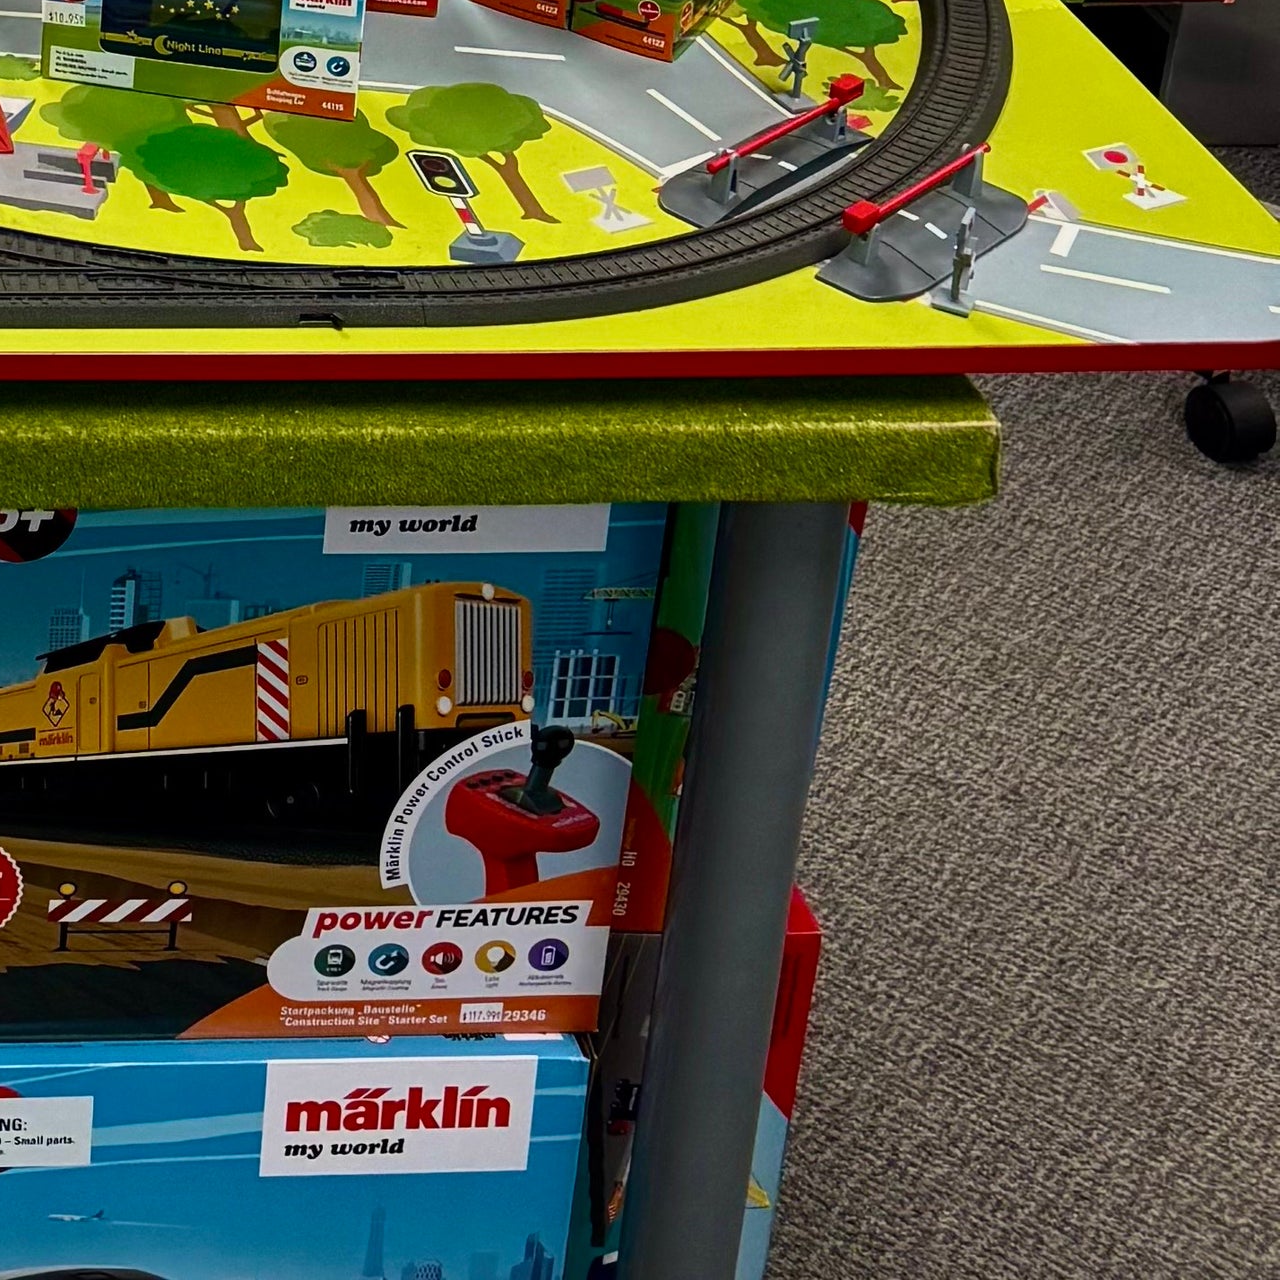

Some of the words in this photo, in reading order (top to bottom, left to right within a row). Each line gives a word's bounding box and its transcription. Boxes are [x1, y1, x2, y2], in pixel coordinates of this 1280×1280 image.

[166, 40, 196, 53] Night
[198, 43, 222, 55] Line
[349, 517, 393, 536] my
[398, 513, 478, 534] world
[480, 724, 525, 751] Stick
[430, 742, 479, 784] Control
[391, 783, 430, 825] Power
[384, 825, 404, 882] Märklin
[312, 908, 433, 939] power
[435, 905, 579, 929] FEATURES
[280, 1005, 355, 1017] Startpackung
[388, 1015, 427, 1025] Starter
[429, 1014, 448, 1024] Set
[503, 1010, 547, 1022] 29346
[14, 1135, 43, 1147] Small
[46, 1134, 75, 1147] parts.
[284, 1142, 324, 1160] my
[331, 1138, 406, 1157] world
